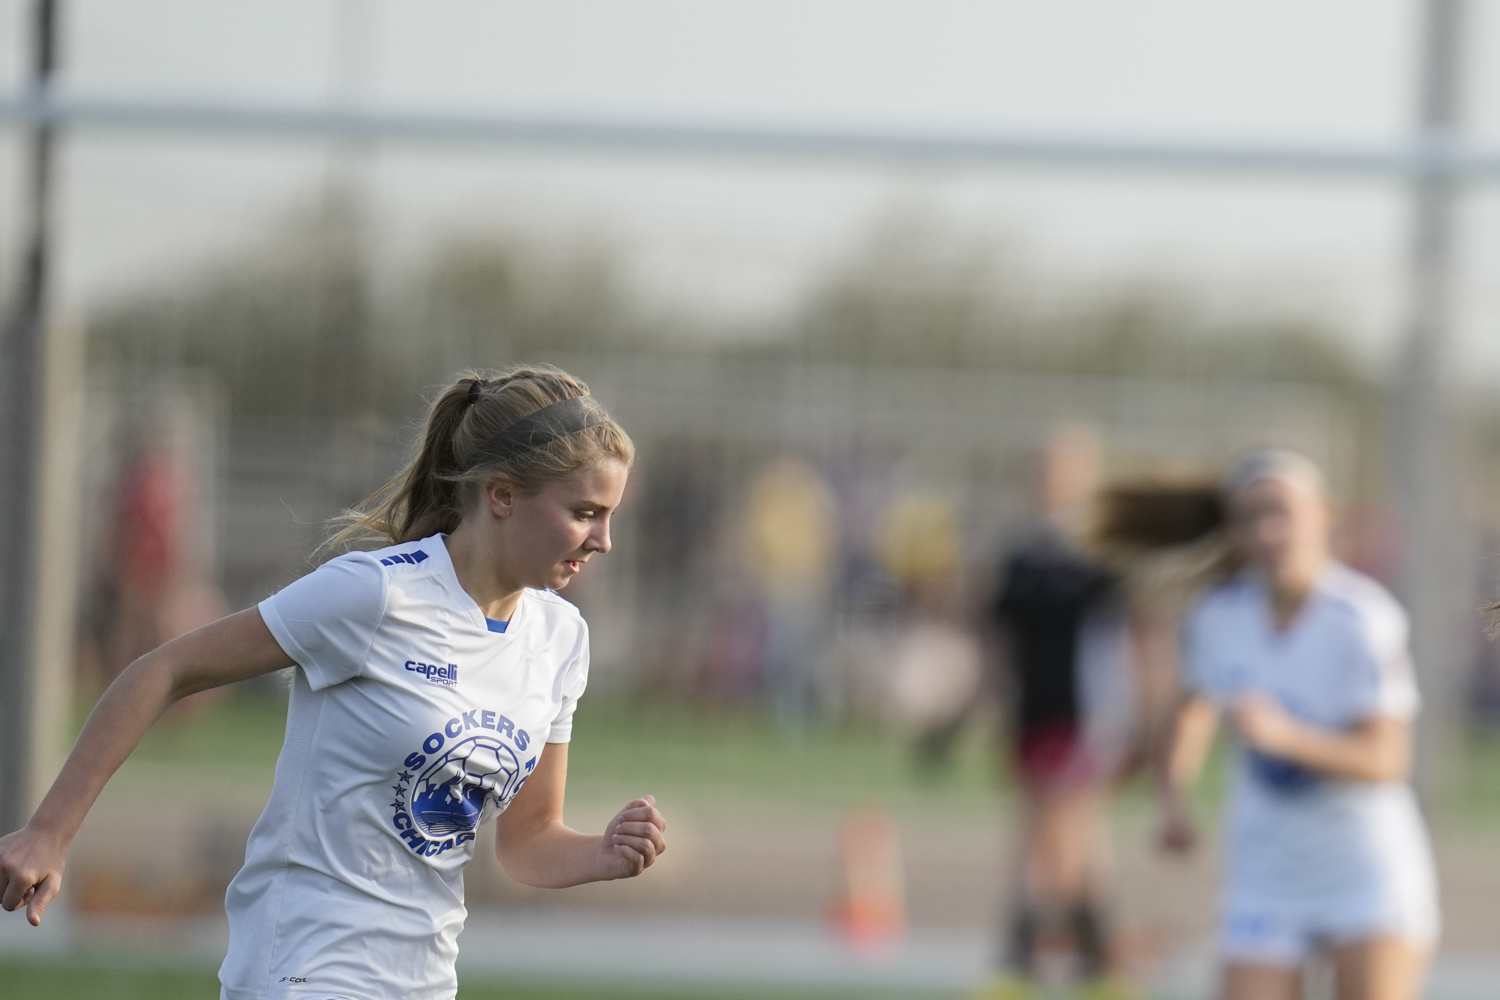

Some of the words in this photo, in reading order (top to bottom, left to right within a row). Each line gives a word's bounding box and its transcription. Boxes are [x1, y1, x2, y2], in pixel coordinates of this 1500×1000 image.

[404, 660, 458, 681] capelli
[430, 676, 458, 688] SPORT
[403, 709, 531, 771] SOCKERS
[393, 812, 475, 858] CHICAG
